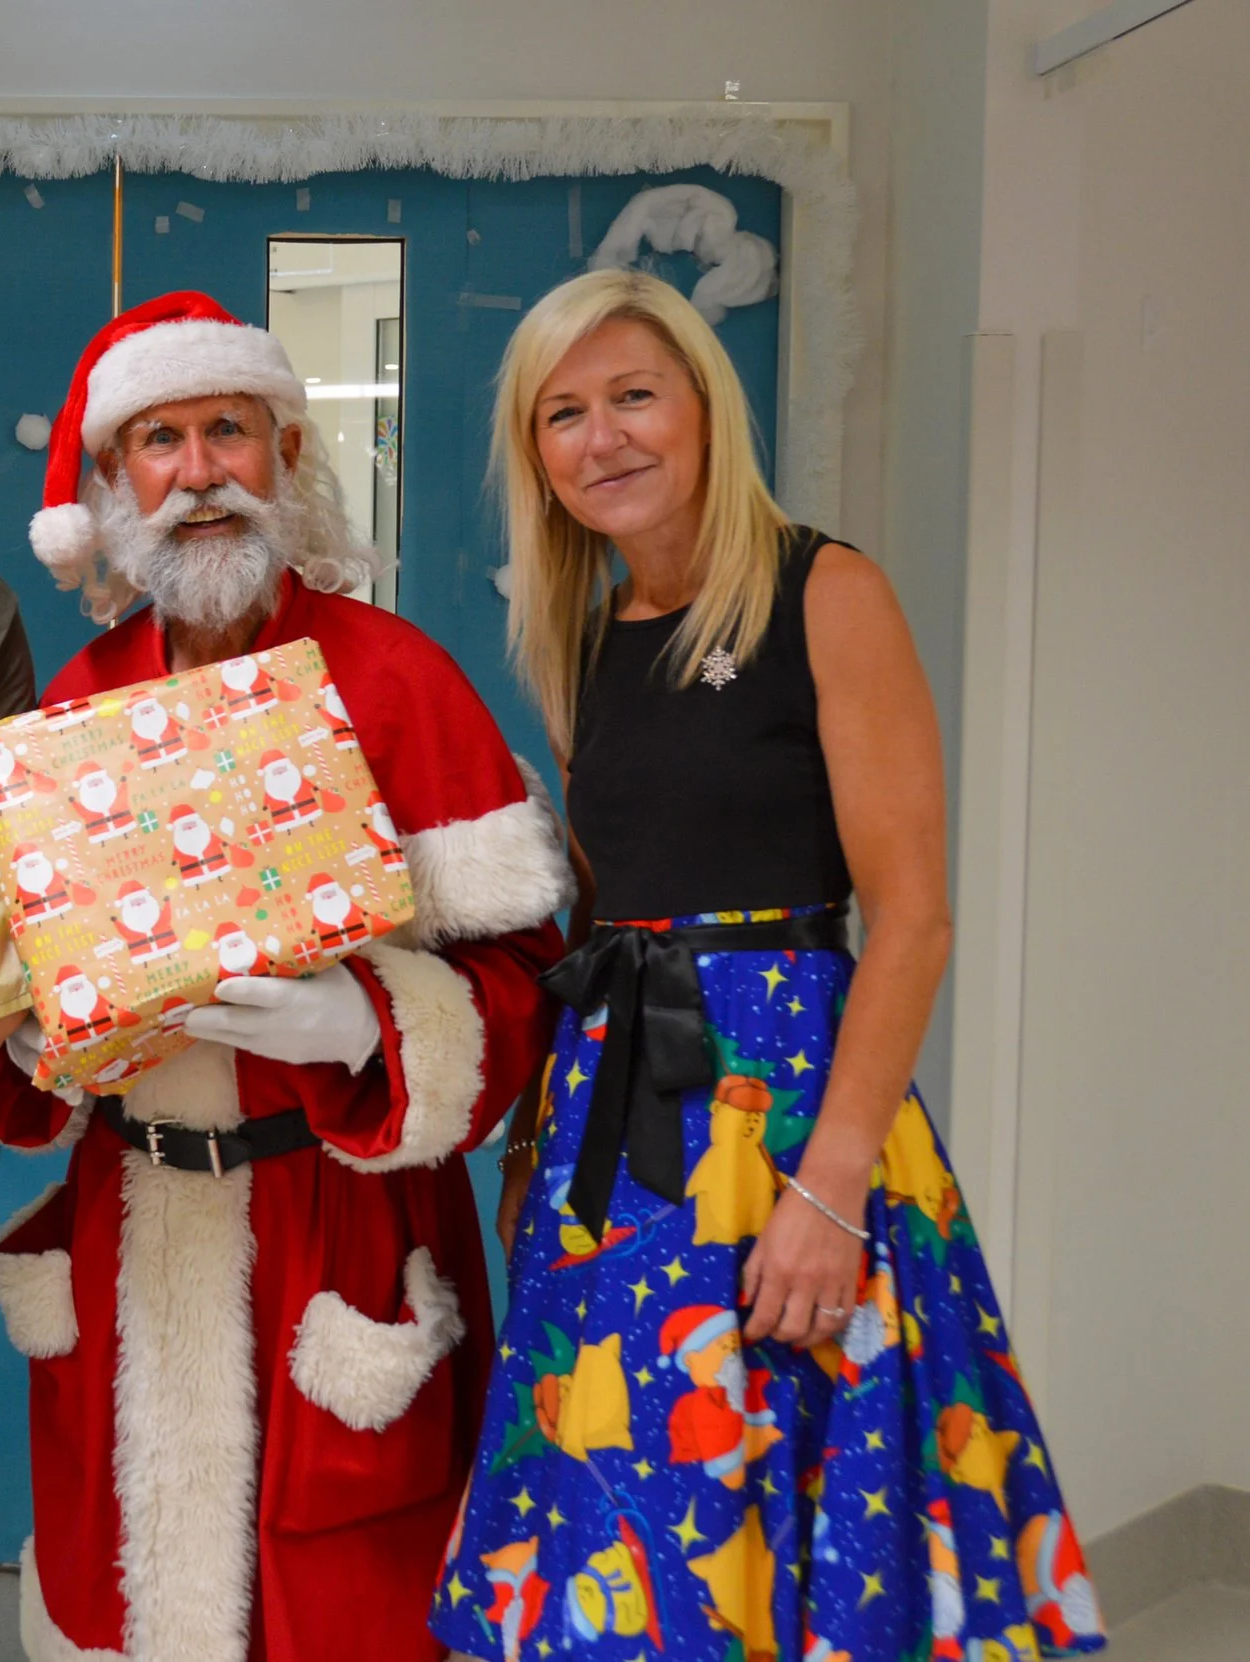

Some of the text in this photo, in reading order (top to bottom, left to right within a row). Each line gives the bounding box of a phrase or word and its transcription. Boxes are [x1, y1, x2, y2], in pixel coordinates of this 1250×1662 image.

[62, 727, 104, 750] MERRY
[239, 713, 287, 741] ON THE
[51, 734, 125, 769] CHRISTMAS
[236, 735, 267, 757] NICE
[271, 723, 300, 743] LIST
[229, 774, 247, 789] HO
[234, 787, 252, 803] HO
[240, 801, 258, 816] HO
[285, 828, 333, 856] ON THE
[105, 844, 147, 867] MERRY
[281, 852, 314, 873] NICE
[318, 839, 347, 860] LIST
[96, 852, 166, 886] CHRISTMAS
[195, 900, 211, 913] LA
[214, 893, 230, 906] LA
[275, 893, 293, 908] HO
[280, 906, 298, 921] HO
[34, 922, 82, 948] ON THE
[286, 920, 303, 934] HO
[31, 945, 62, 965] NICE
[65, 933, 96, 954] LIST
[146, 961, 189, 984] MERRY
